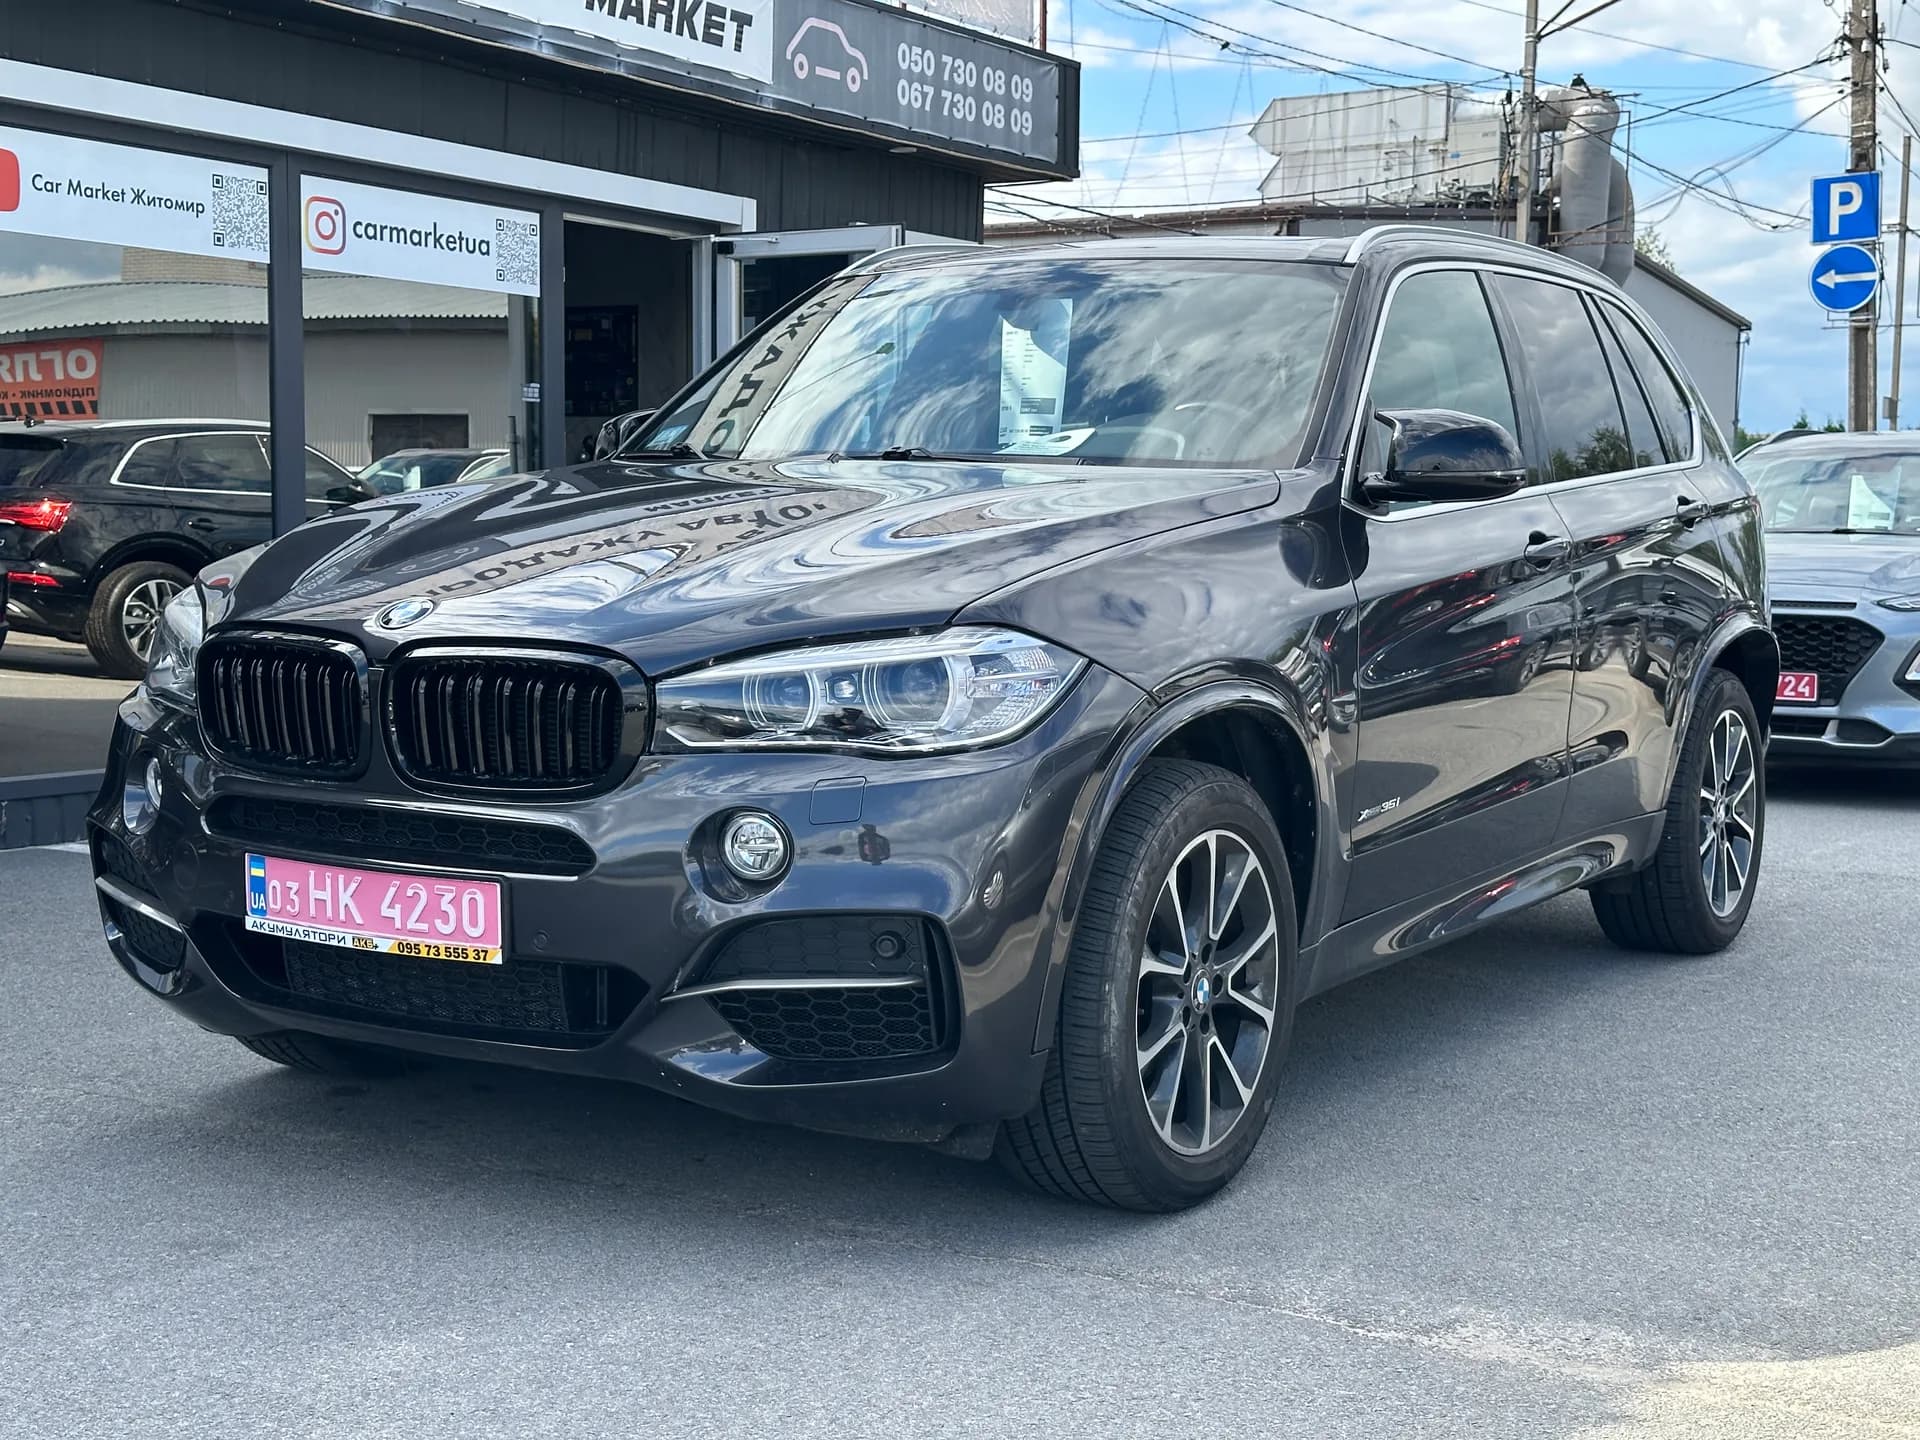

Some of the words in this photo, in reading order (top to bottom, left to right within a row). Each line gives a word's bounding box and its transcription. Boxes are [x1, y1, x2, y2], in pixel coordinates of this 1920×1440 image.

[897, 42, 935, 77] 050
[941, 54, 977, 88] 730
[982, 66, 1006, 95] 08
[1010, 74, 1033, 103] 09
[896, 78, 935, 112] 067
[941, 89, 977, 122] 730
[981, 100, 1005, 129] 08
[1010, 108, 1033, 136] 09
[31, 173, 62, 194] Car
[66, 178, 126, 203] Market
[130, 187, 206, 218] Житомир
[1829, 181, 1863, 236] P
[352, 221, 491, 257] carmarketua
[251, 892, 266, 911] UA
[380, 880, 486, 938] 4230
[251, 919, 347, 945] АКУМУЛЯТОРИ
[397, 941, 422, 956] 095
[424, 944, 441, 957] 73
[444, 945, 469, 960] 555
[472, 948, 489, 962] 37
